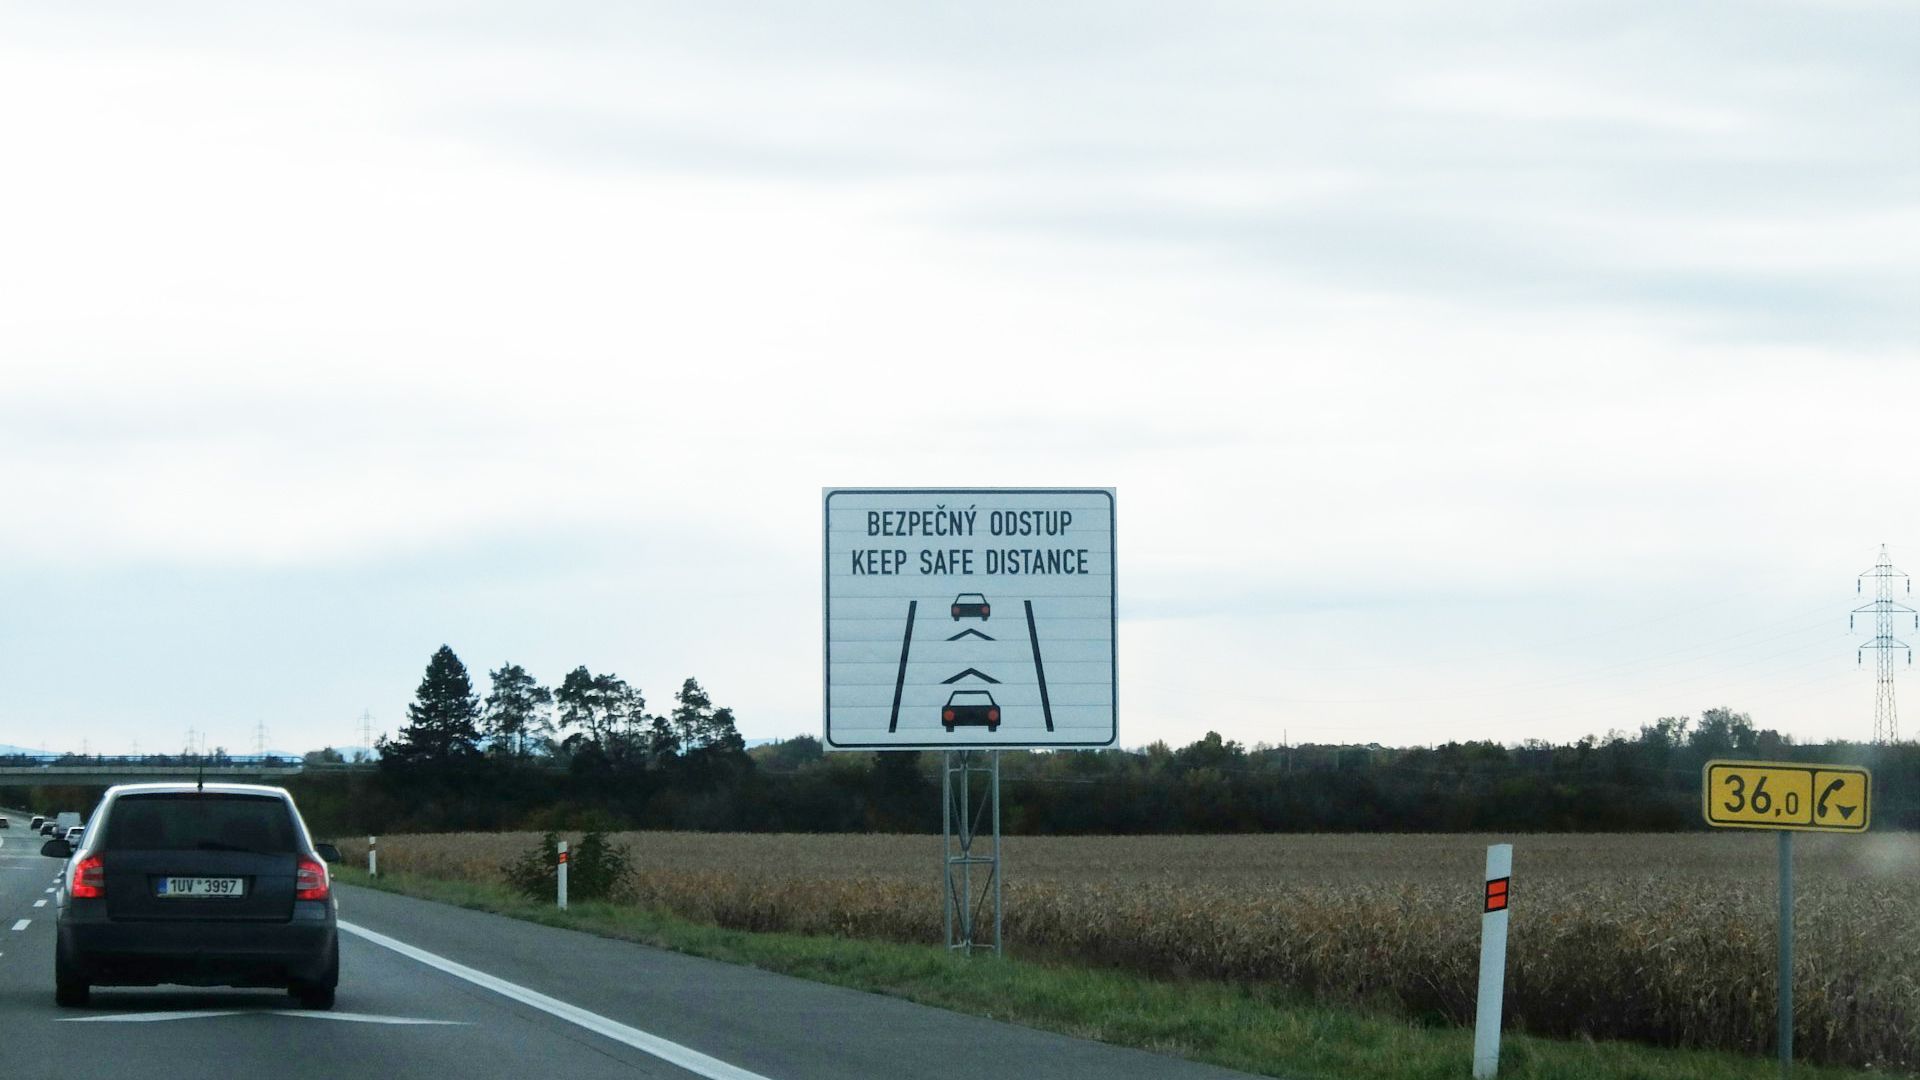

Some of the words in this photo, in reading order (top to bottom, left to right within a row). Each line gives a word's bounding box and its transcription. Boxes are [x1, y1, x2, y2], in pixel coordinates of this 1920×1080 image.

[867, 504, 977, 536] BEZPEČNÝ
[990, 510, 1072, 536] ODSTUP
[852, 549, 907, 575] KEEP
[919, 549, 974, 575] SAFE
[986, 549, 1089, 575] DISTANCE
[1724, 774, 1799, 817] 36,0
[170, 879, 193, 892] 1UV
[204, 879, 237, 893] 3997
